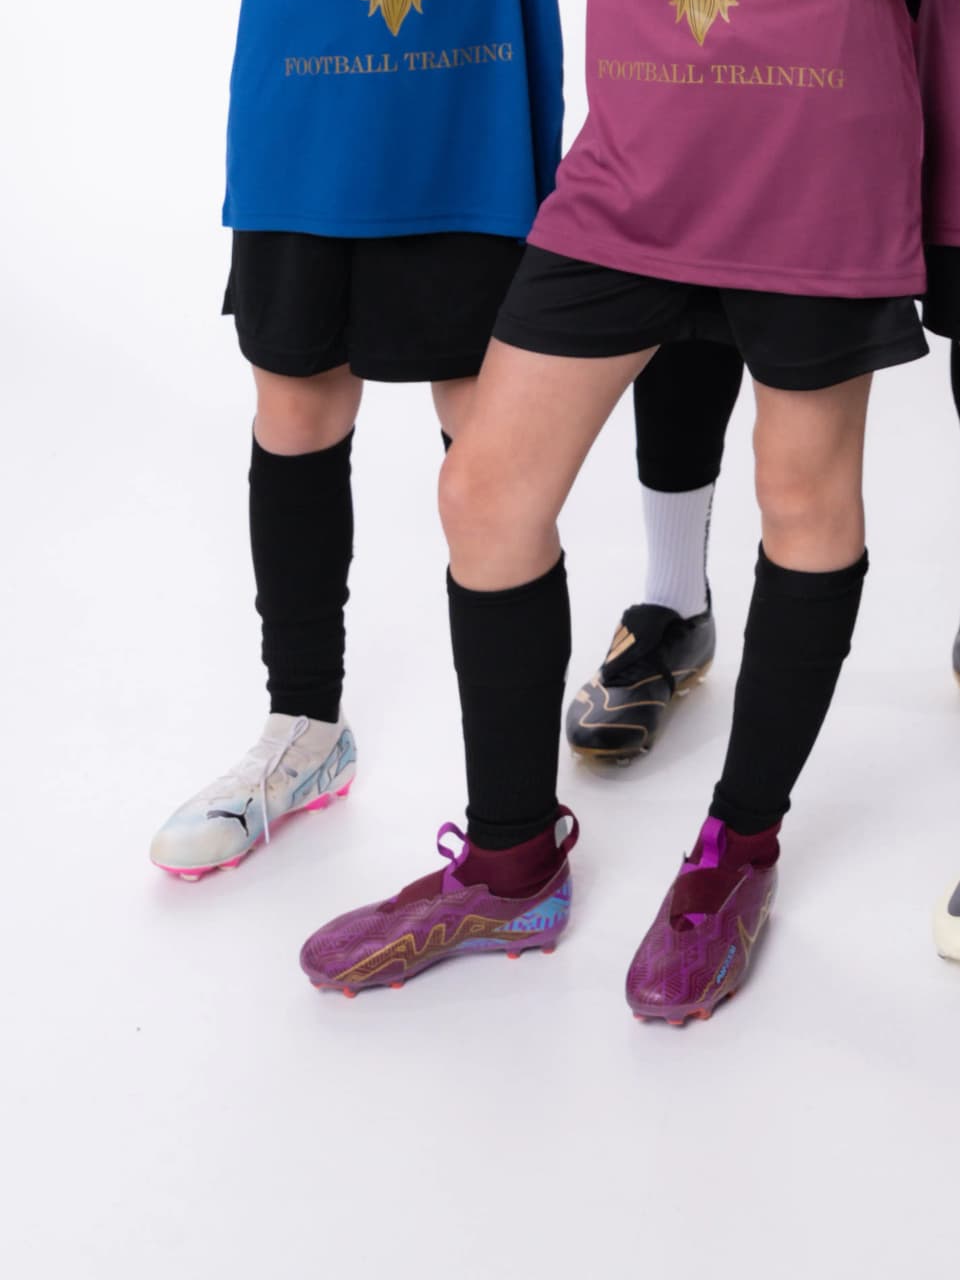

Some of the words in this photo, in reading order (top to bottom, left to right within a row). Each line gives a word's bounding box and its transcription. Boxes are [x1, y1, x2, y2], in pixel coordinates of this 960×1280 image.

[284, 54, 398, 77] FOOTBALL
[404, 42, 513, 71] TRAINING
[597, 59, 704, 84] FOOTBALL
[710, 64, 847, 89] TRAINING
